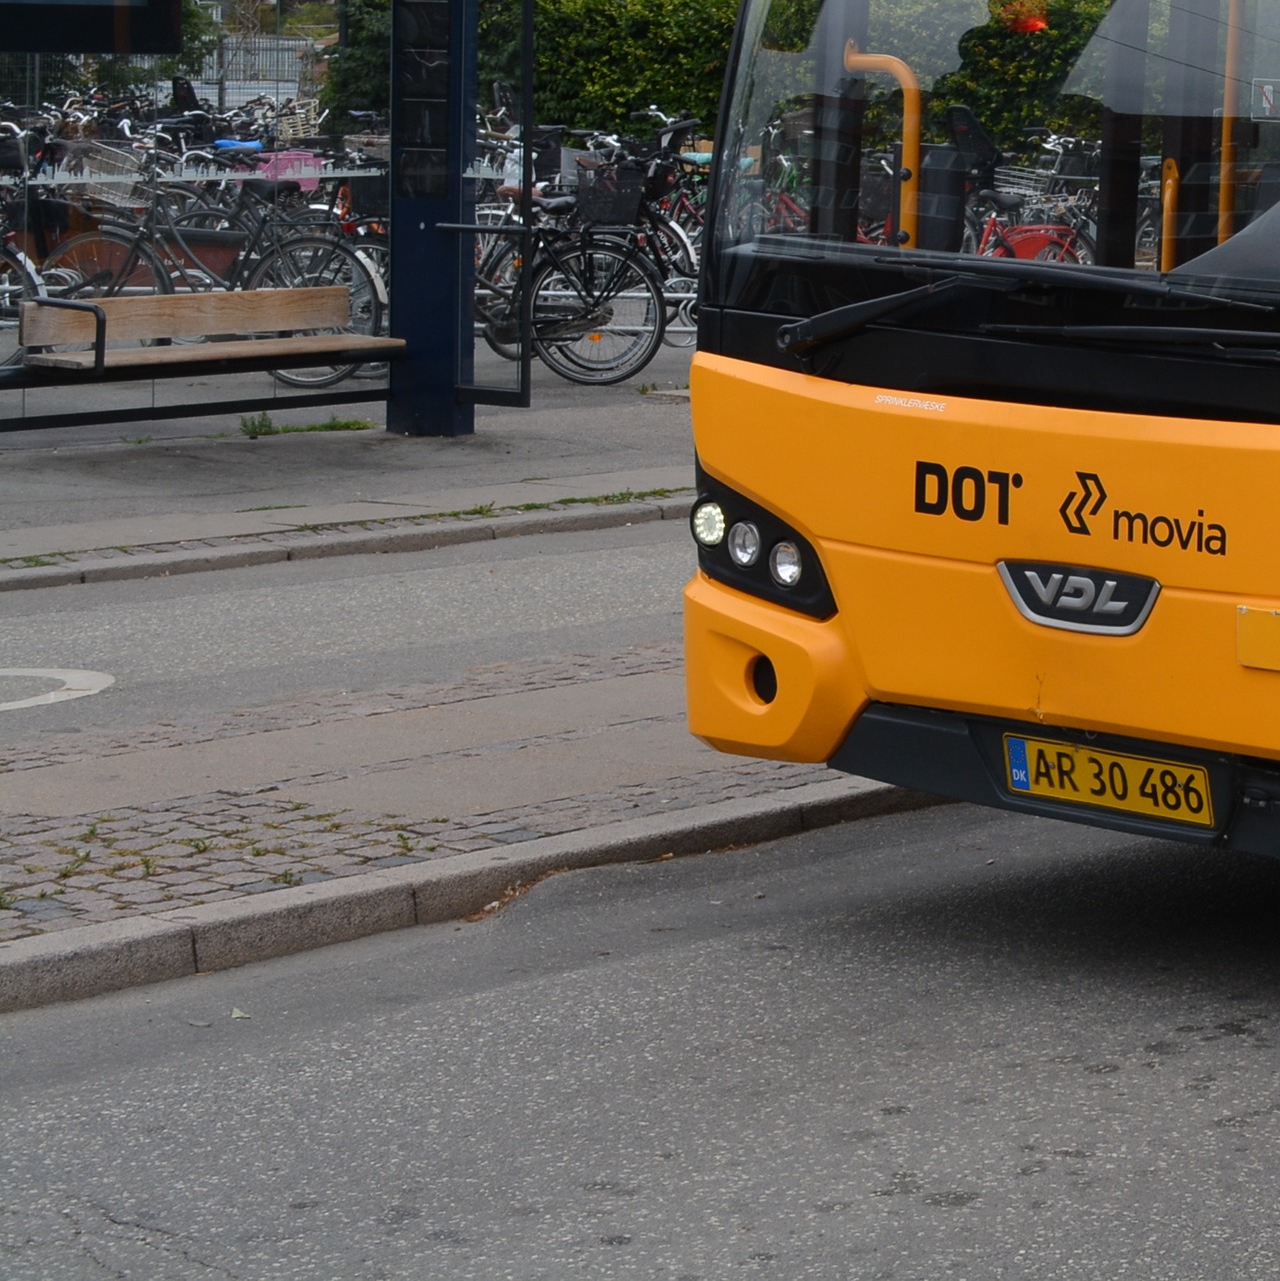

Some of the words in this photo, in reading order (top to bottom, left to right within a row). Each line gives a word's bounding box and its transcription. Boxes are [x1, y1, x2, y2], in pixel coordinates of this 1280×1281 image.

[914, 460, 1023, 526] DOT
[1112, 509, 1227, 556] movia
[1024, 570, 1129, 615] VDL
[1012, 768, 1028, 783] DK
[1033, 748, 1080, 792] AR
[1087, 756, 1129, 801] 30
[1139, 767, 1204, 814] 486
